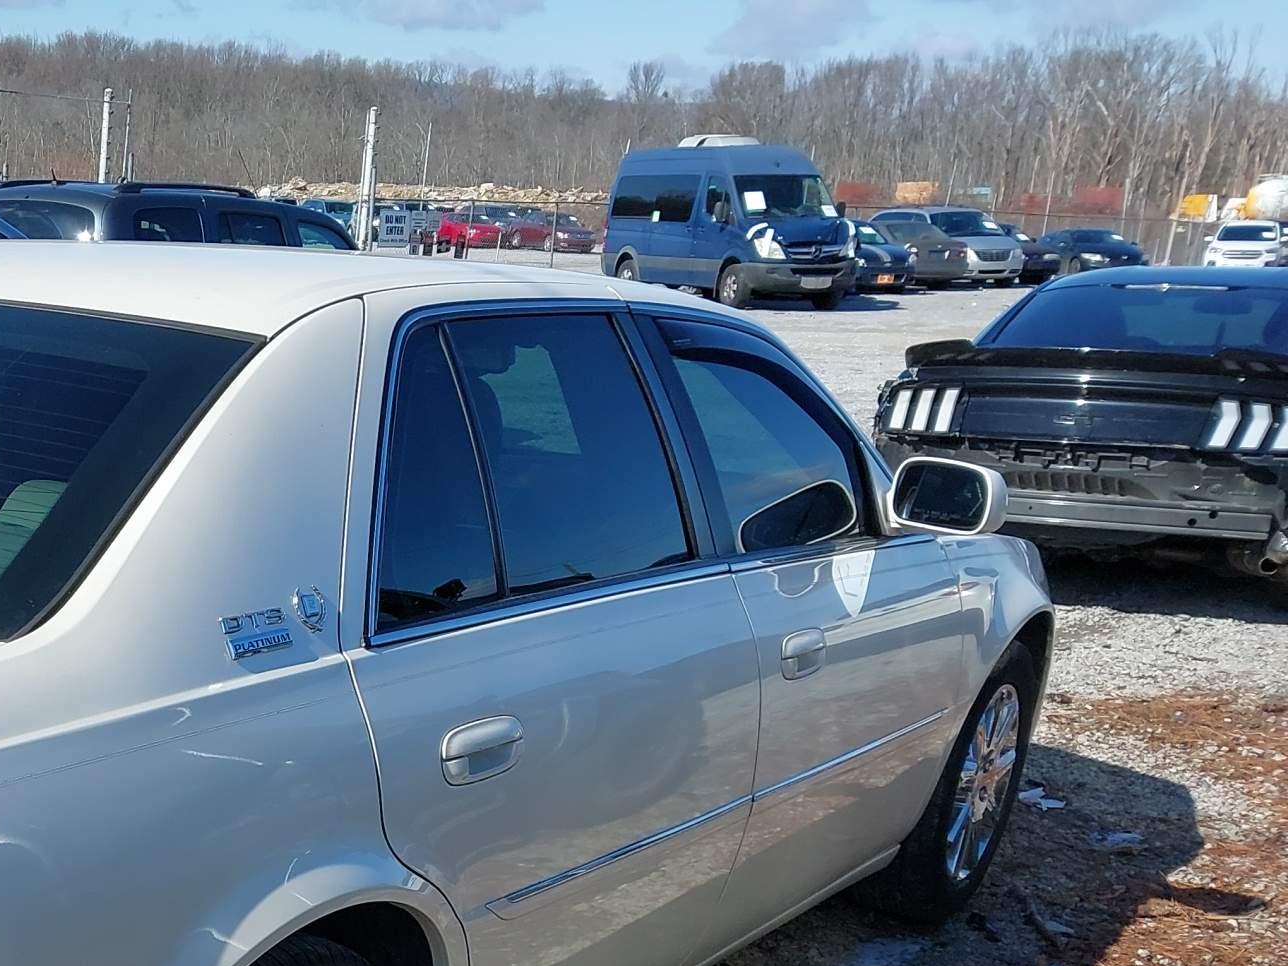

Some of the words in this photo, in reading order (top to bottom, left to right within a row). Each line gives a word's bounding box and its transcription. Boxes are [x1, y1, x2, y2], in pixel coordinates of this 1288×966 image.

[385, 215, 393, 224] DO
[395, 215, 406, 224] NOT
[386, 226, 404, 235] ENTER
[219, 607, 286, 635] DTS
[233, 632, 292, 653] PLATINUM
